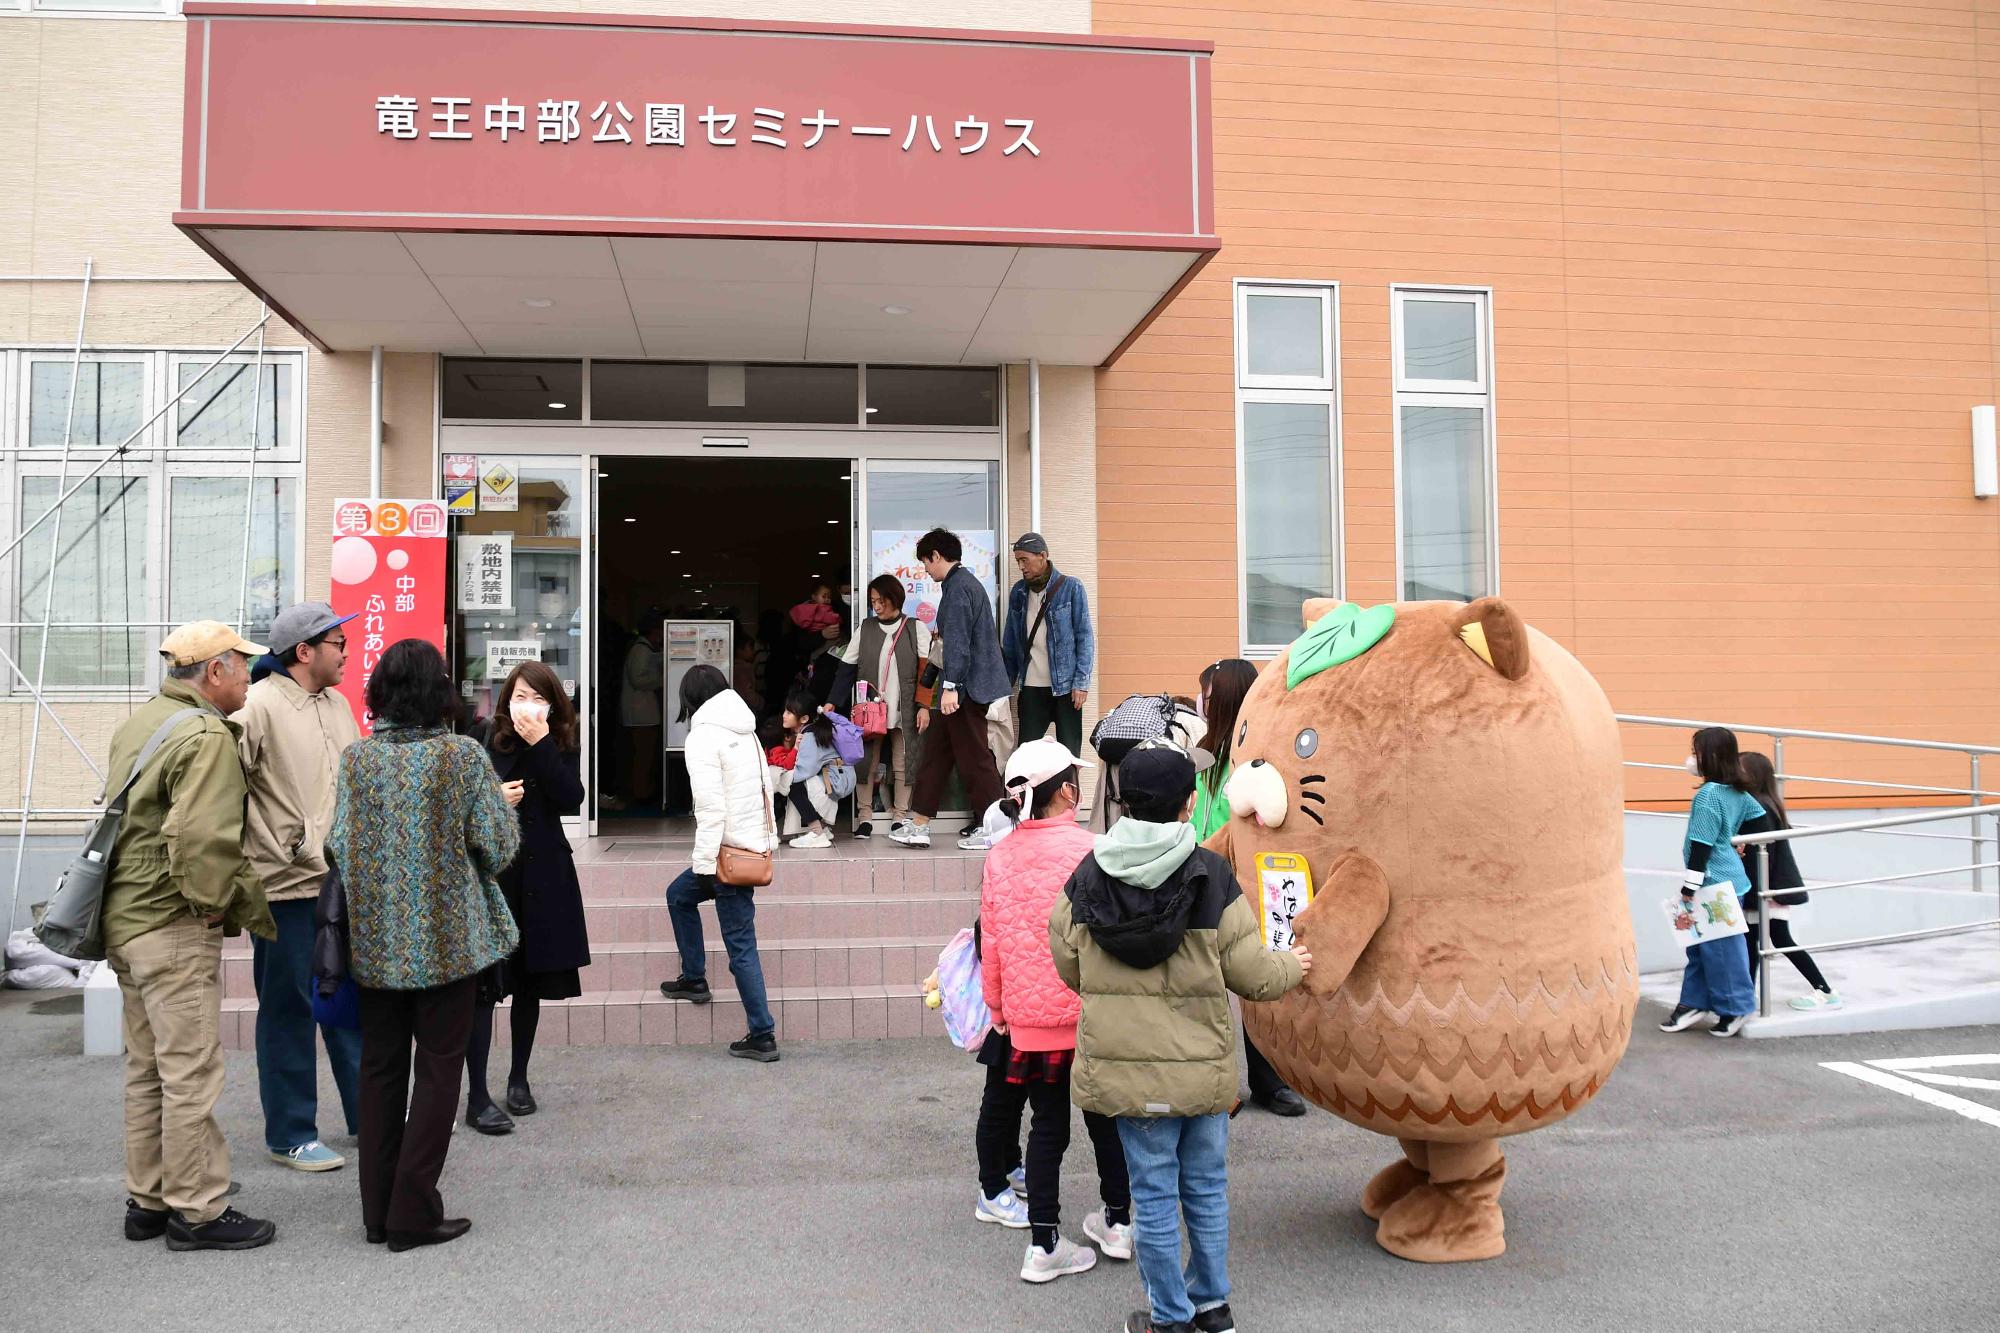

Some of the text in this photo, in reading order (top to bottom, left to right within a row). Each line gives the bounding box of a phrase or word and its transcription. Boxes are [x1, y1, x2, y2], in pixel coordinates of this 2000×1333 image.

[375, 94, 1041, 157] 竜王中部公園セミナーハウス
[340, 506, 441, 533] 第3回
[395, 574, 416, 612] 中部
[481, 543, 503, 605] 敷地内禁煙
[491, 646, 537, 657] 自動販売機
